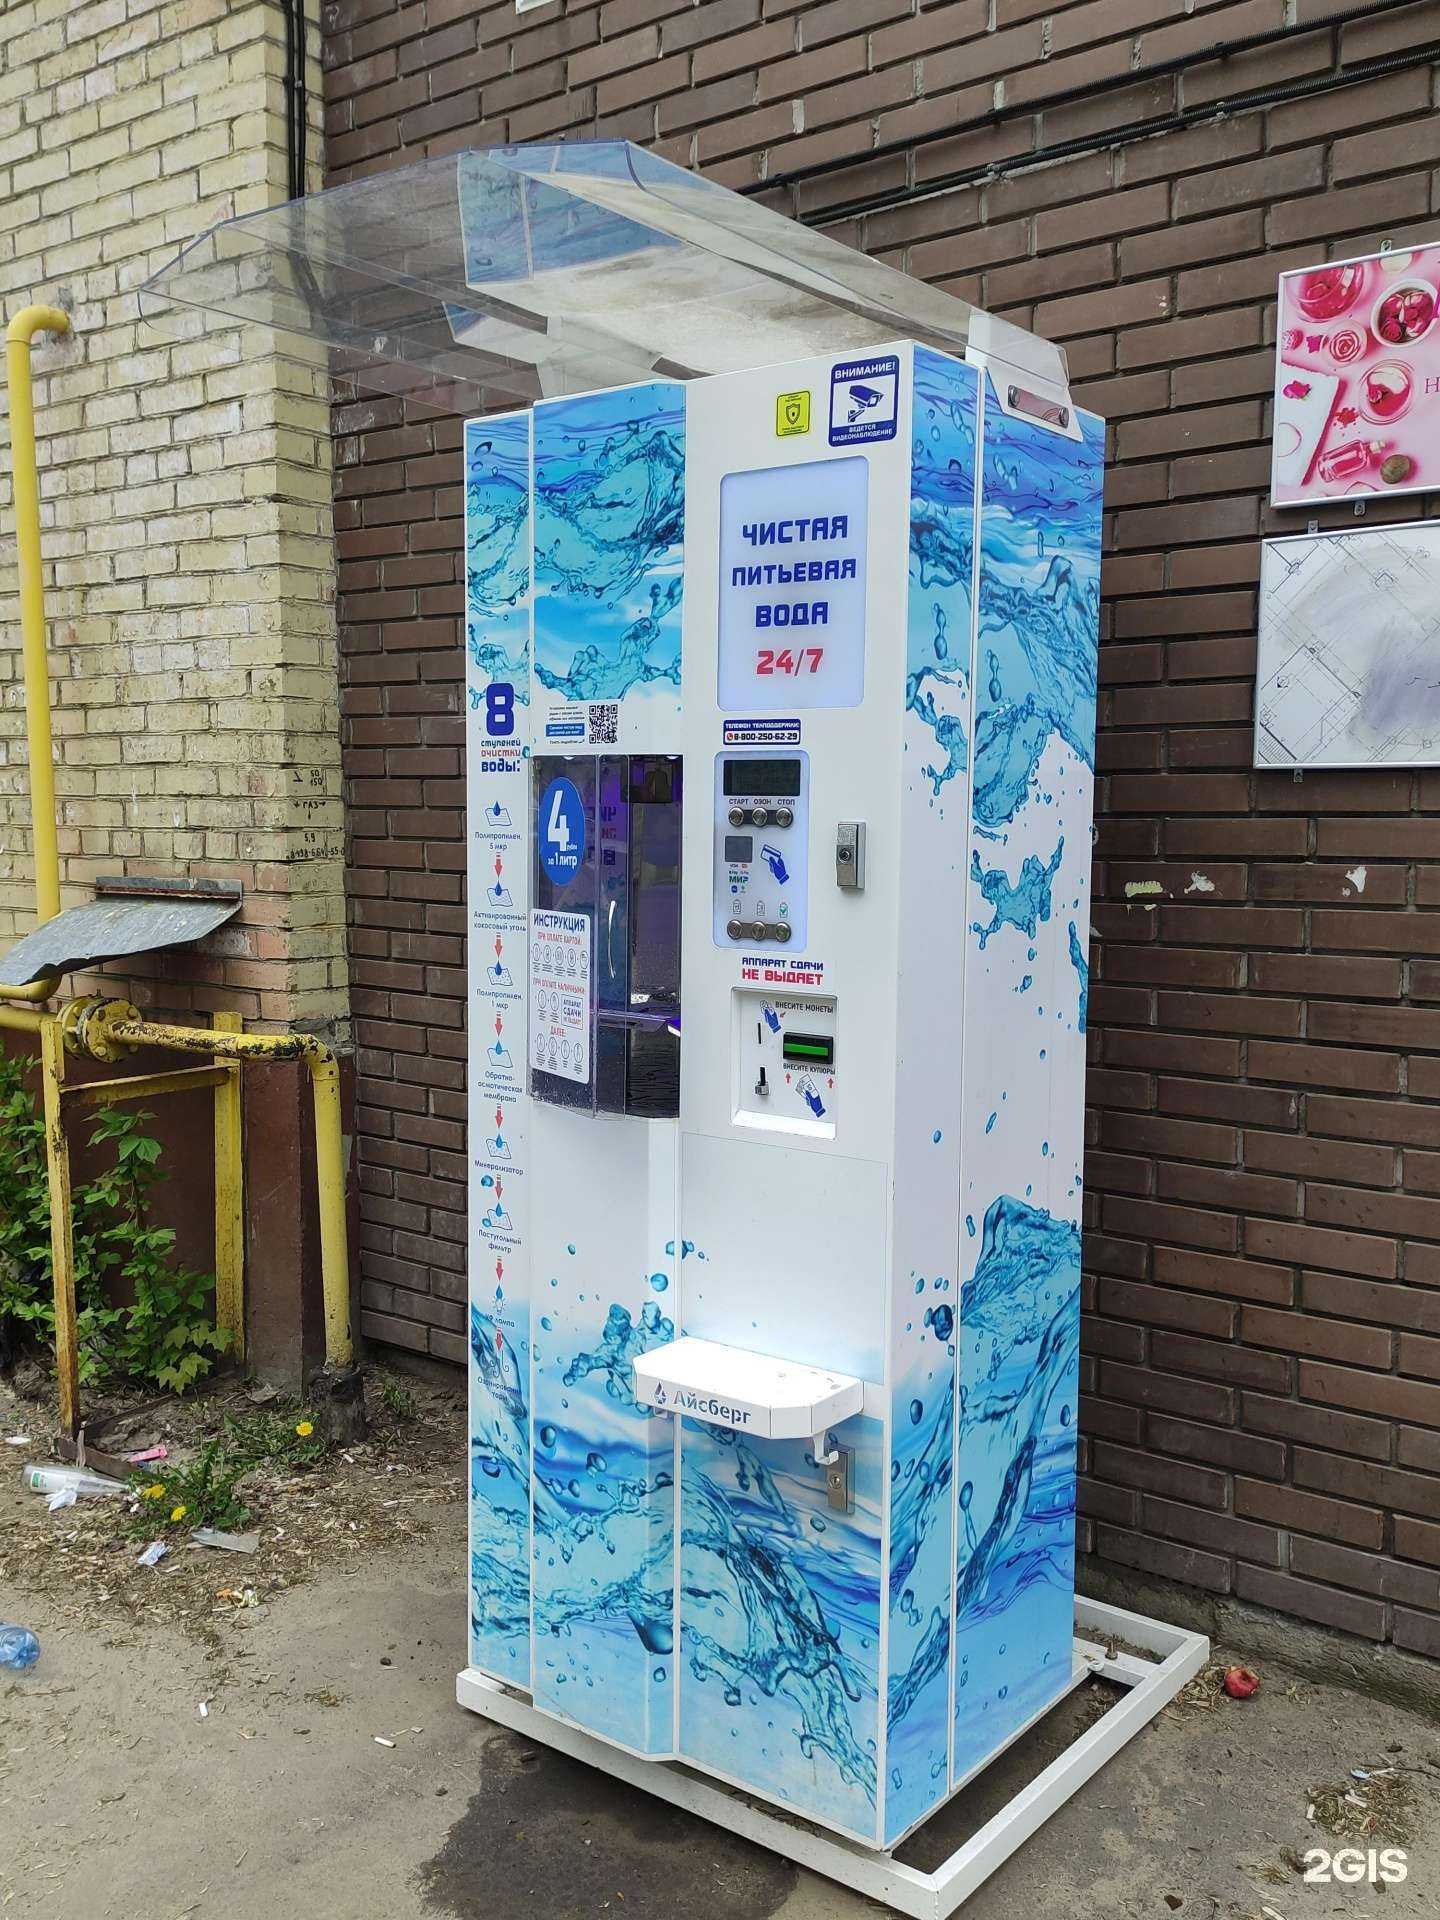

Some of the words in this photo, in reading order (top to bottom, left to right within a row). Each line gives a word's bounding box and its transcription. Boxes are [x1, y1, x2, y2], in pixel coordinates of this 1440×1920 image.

[834, 361, 896, 379] ВНИМАНИЕ!
[832, 428, 892, 442] ВИДЕОНАБЛЮДЕНИЕ
[848, 424, 876, 432] ВЕДЕТСЯ
[742, 515, 848, 546] ЧИСТАЯ
[732, 558, 856, 587] ПИТЬЕВАЯ
[755, 602, 828, 627] ВОДА
[756, 648, 824, 676] 24/7
[486, 683, 514, 736] 8
[480, 738, 520, 748] ступеней
[734, 732, 798, 740] 8-800-250-62-29
[481, 749, 520, 757] очистки
[481, 758, 520, 772] воды:
[548, 790, 570, 852] 4
[560, 856, 578, 870] литр
[474, 912, 526, 921] Активированный
[534, 913, 585, 933] ИНСТРУКЦИЯ
[474, 922, 508, 930] кокосовый
[509, 924, 526, 932] уголь
[742, 958, 786, 968] АППАРАТ
[790, 960, 823, 971] СДАЧИ
[742, 968, 759, 980] НЕ
[764, 970, 823, 985] ВЫДАЕТ
[496, 1002, 508, 1010] мкр
[775, 1001, 803, 1010] ВНЕСИТЕ
[806, 1004, 834, 1013] МОНЕТЫ
[783, 1063, 808, 1072] ВНЕСИТЕ
[810, 1066, 835, 1075] КУПЮРЫ
[478, 1082, 522, 1093] осмотическая
[484, 1092, 517, 1103] мембрана
[475, 1160, 523, 1175] Минерализатор
[478, 1229, 522, 1245] Постугольный
[488, 1242, 512, 1254] фильтр
[672, 1390, 751, 1424] Айсберг
